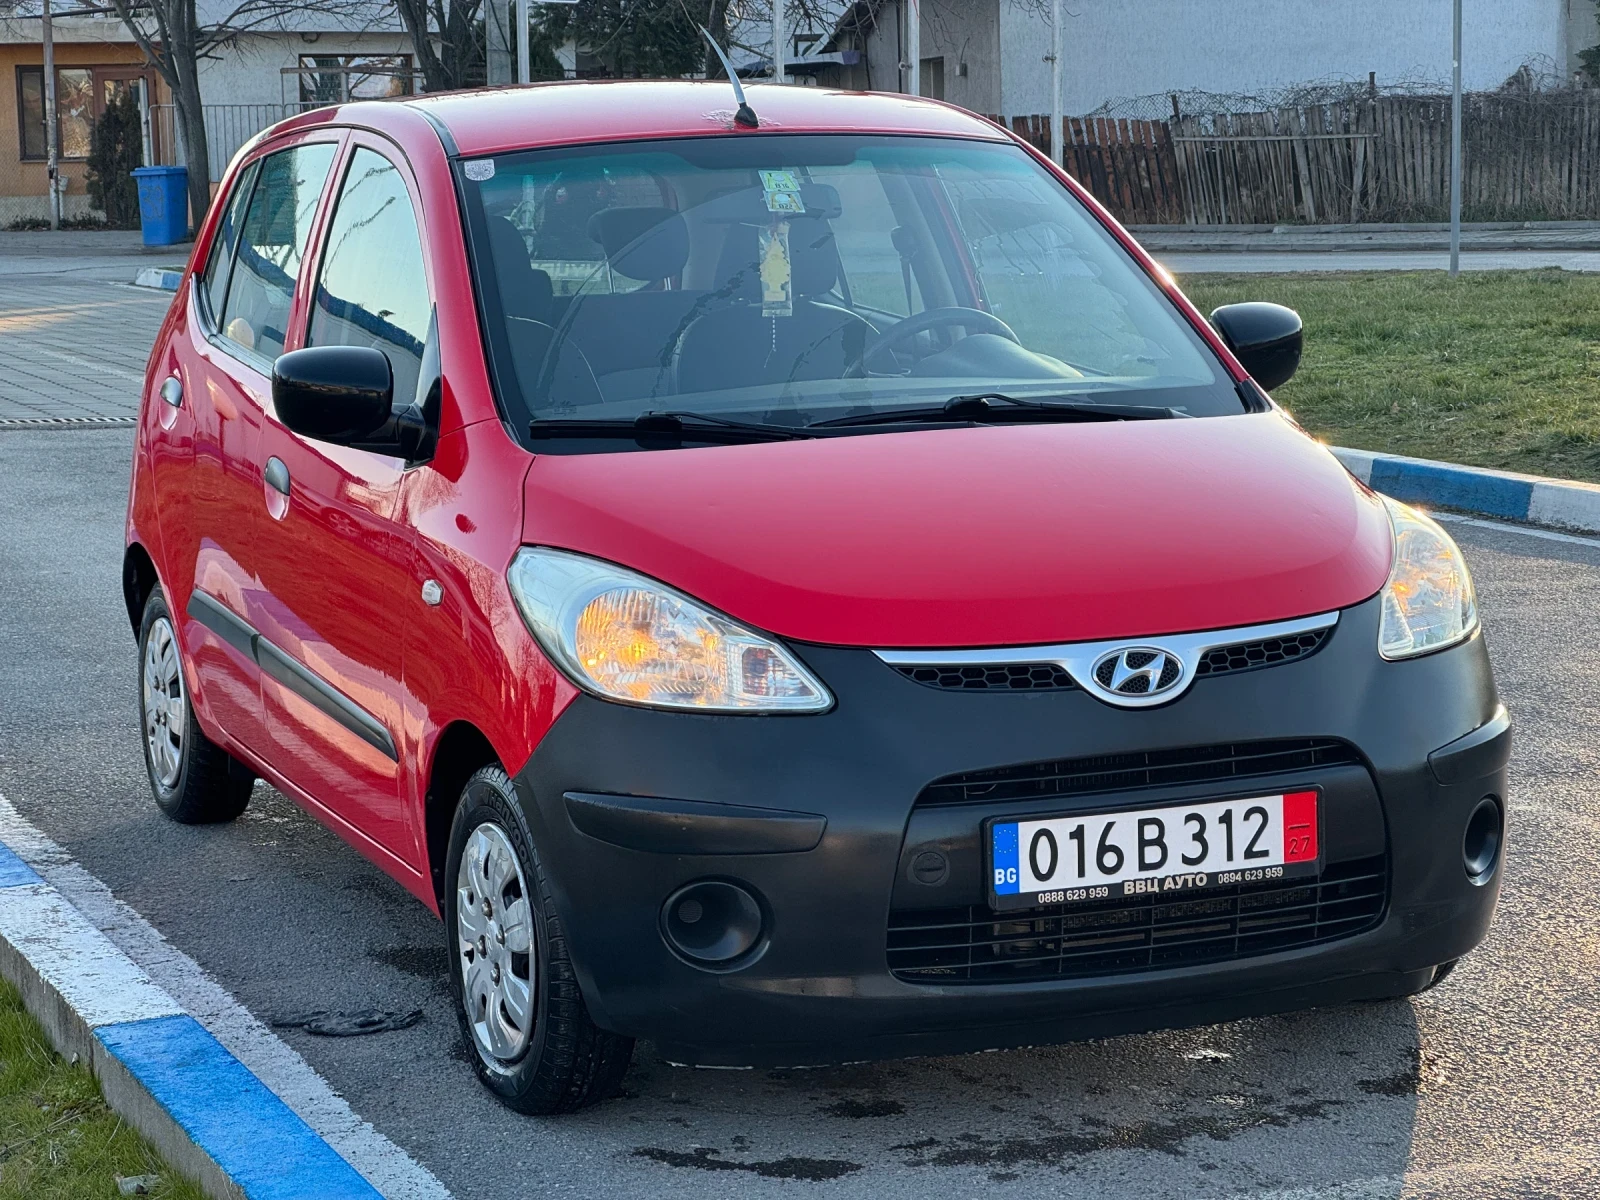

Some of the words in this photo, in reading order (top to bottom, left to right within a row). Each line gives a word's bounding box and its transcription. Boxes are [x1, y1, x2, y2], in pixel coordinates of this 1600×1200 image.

[1288, 835, 1310, 856] 27
[994, 868, 1017, 885] BG
[1124, 878, 1160, 895] ВВЦ
[1163, 873, 1208, 891] АУТО
[1218, 871, 1243, 884] 0894
[1244, 869, 1264, 881] 629
[1265, 867, 1284, 879] 959
[1037, 891, 1065, 903] 0888
[1066, 889, 1086, 901] 629
[1088, 887, 1109, 899] 959
